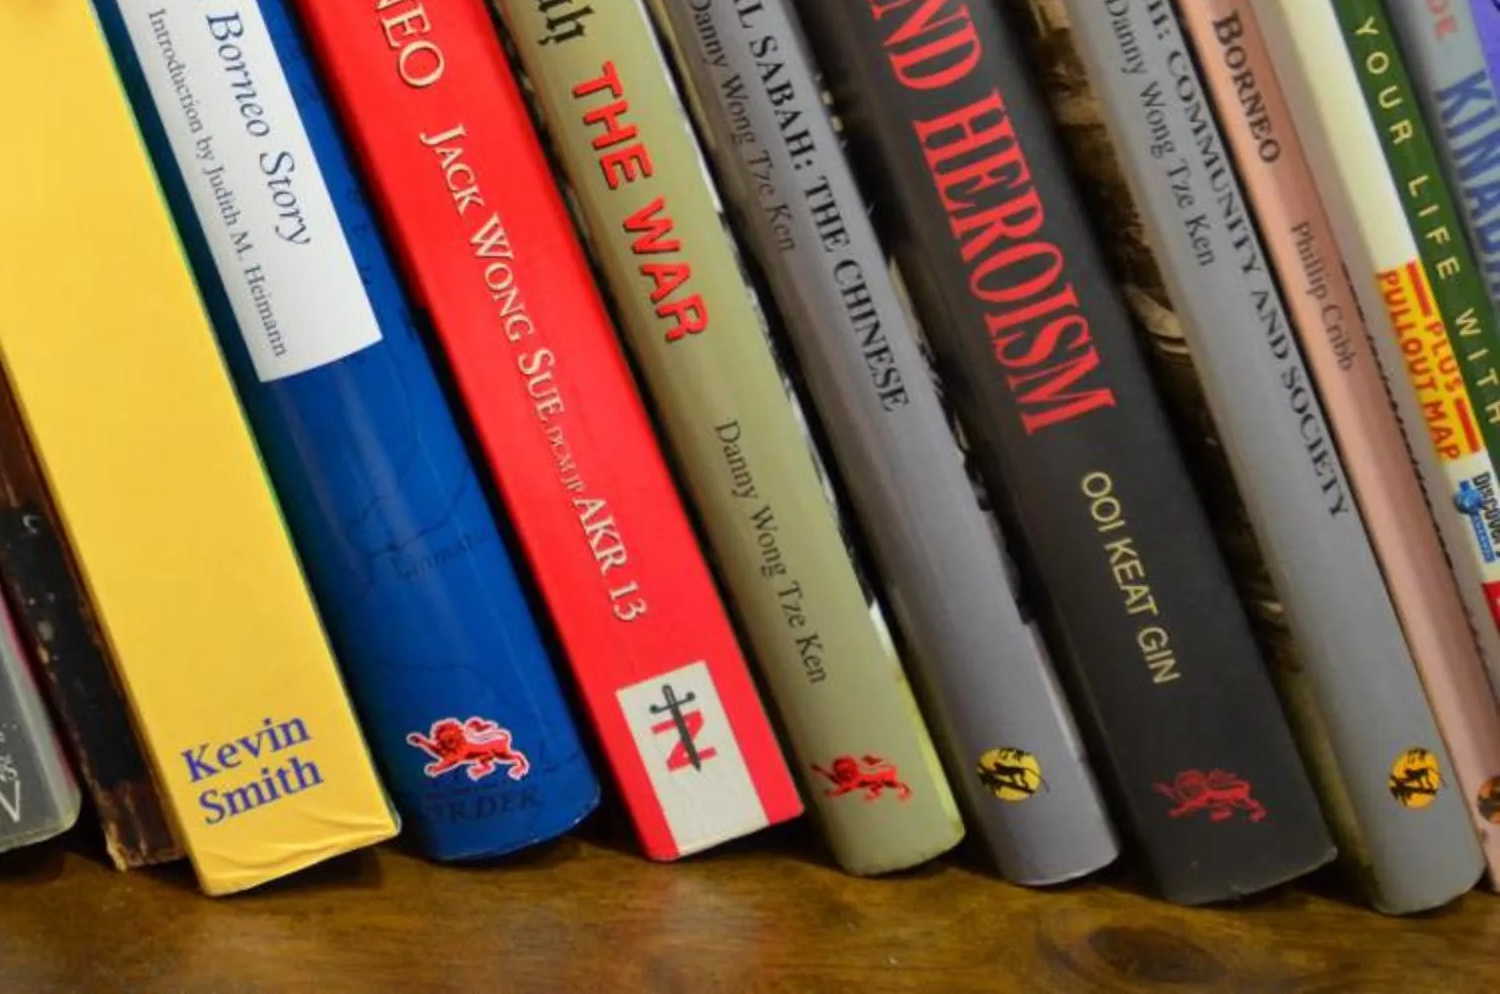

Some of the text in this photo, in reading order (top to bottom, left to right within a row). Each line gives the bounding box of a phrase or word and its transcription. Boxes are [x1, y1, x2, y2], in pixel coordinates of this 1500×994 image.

[148, 9, 204, 134] Introduction
[196, 137, 217, 162] by
[207, 12, 270, 140] Borneo
[259, 149, 312, 247] Story
[721, 74, 756, 146] Wong
[754, 148, 779, 199] Tze
[768, 202, 797, 254] Ken
[206, 164, 242, 228] Judith
[232, 232, 258, 262] M.
[749, 35, 815, 172] SABAH:
[803, 175, 850, 252] THE
[835, 258, 909, 413] CHINESE
[1139, 81, 1175, 159] Wong
[1166, 159, 1194, 212] Tze
[1184, 215, 1215, 268] Ken
[1210, 9, 1281, 166] BORNEO
[1290, 220, 1331, 303] Phillip
[1317, 299, 1353, 373] Cribb
[1355, 16, 1413, 144] YOUR
[1408, 174, 1460, 280] LIFE
[1455, 308, 1500, 424] WITH
[242, 263, 288, 358] Heimann
[421, 122, 486, 219] JACK
[468, 212, 534, 342] WONG
[518, 347, 565, 423] SUE
[573, 496, 627, 574] AKR
[610, 581, 647, 622] 13
[572, 61, 655, 192] THE
[623, 197, 709, 343] WAR
[715, 420, 762, 504] Danny
[750, 504, 785, 580] Wong
[779, 582, 806, 628] Tze
[794, 632, 826, 686] Ken
[1166, 50, 1262, 277] COMMUNITY
[1251, 288, 1290, 358] AND
[1279, 362, 1350, 521] SOCIETY
[1377, 270, 1437, 391] PULLOUT
[1423, 400, 1460, 460] MAP
[1426, 321, 1463, 391] PLUS
[911, 91, 1116, 434] HEROISM
[1081, 472, 1124, 533] OOI
[1103, 536, 1158, 632] KEAT
[1136, 626, 1180, 686] GIN
[180, 713, 311, 783] Kevin
[198, 760, 325, 825] Smith
